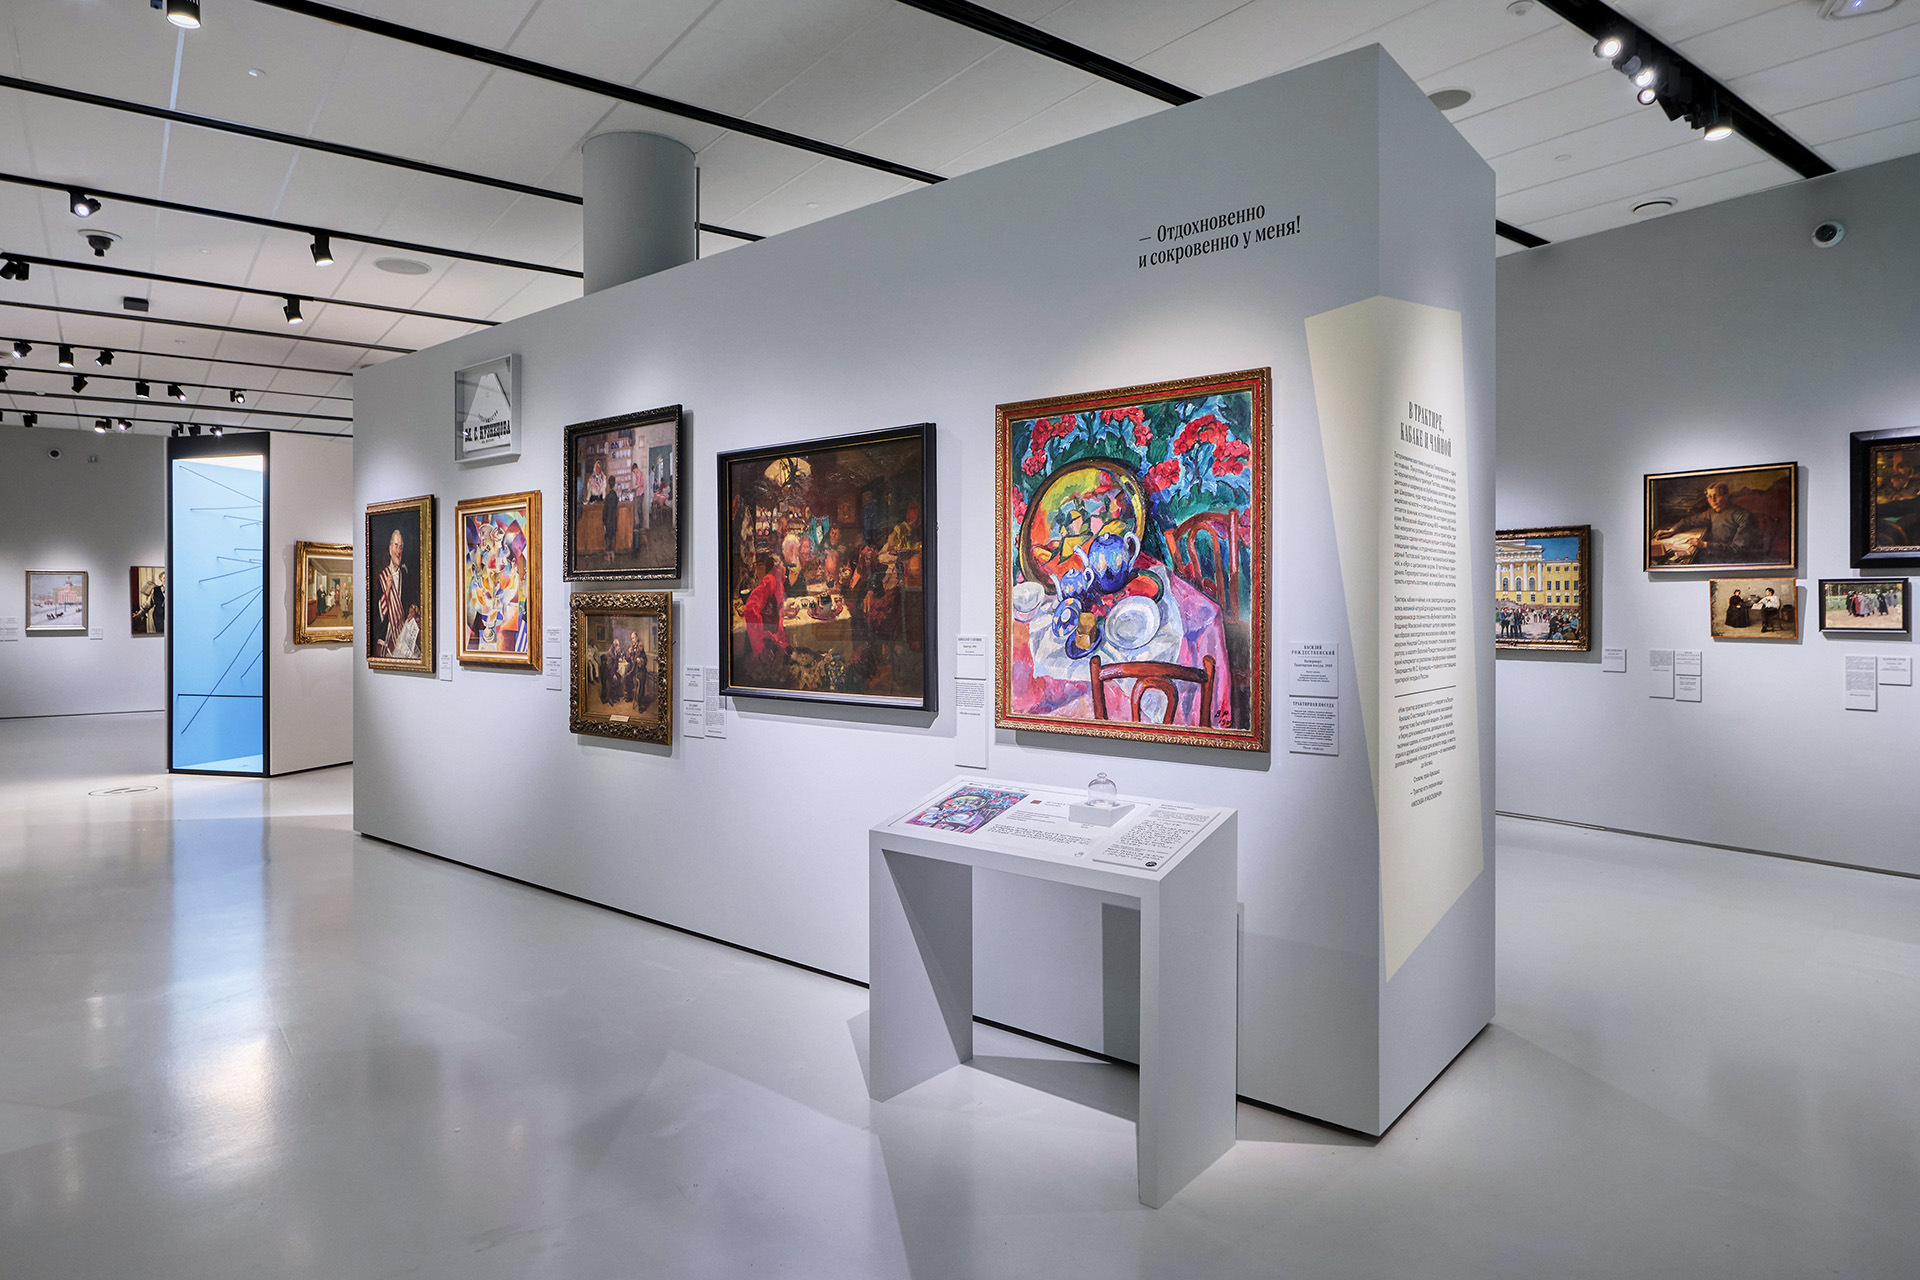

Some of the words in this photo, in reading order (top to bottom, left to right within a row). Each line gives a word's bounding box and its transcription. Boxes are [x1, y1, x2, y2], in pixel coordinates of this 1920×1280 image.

[1138, 254, 1147, 268] и
[1150, 233, 1239, 264] сокровенно
[1243, 230, 1251, 249] у
[1255, 215, 1301, 243] меня!
[1157, 204, 1266, 242] Отдохновенно
[1409, 401, 1413, 419] В
[1414, 403, 1445, 433] ТРАКТИРЕ,
[1400, 422, 1424, 448] КАБАКЕ
[1425, 431, 1429, 450] И
[1430, 433, 1452, 458] ЧАЙНОЙ
